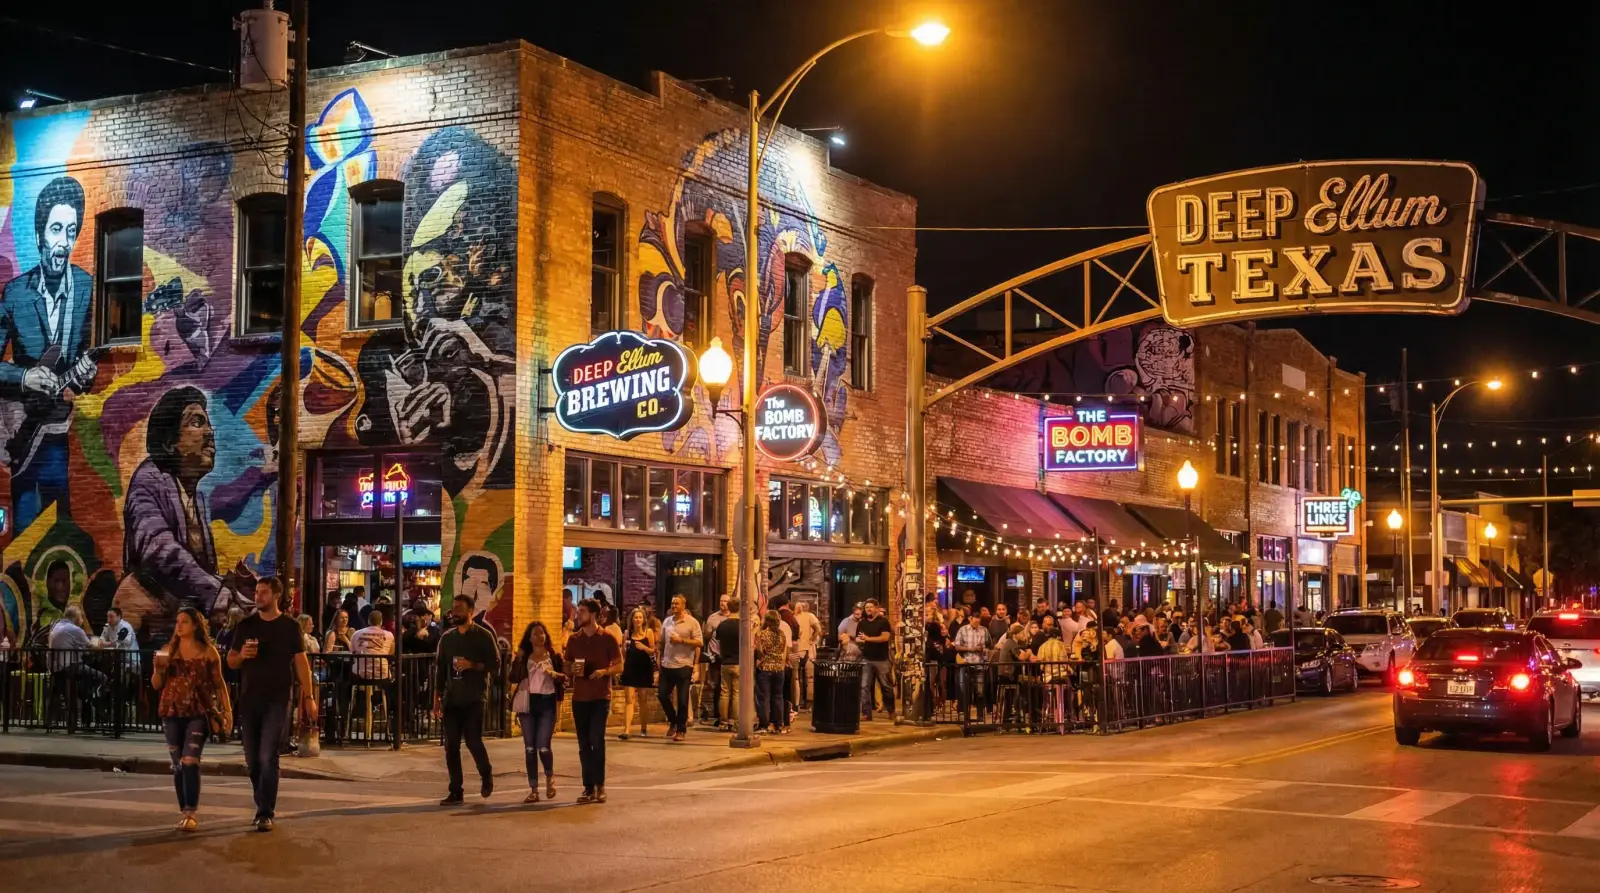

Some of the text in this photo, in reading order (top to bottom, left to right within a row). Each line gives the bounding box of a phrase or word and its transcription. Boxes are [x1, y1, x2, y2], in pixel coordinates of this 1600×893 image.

[1176, 173, 1447, 242] DEEP Ellum
[1176, 237, 1447, 303] TEXAS
[574, 347, 663, 384] DEEP Ellum
[567, 366, 670, 416] BREWING
[637, 398, 664, 418] CO.
[765, 396, 786, 409] The
[765, 409, 805, 425] BOMB
[1076, 409, 1107, 423] THE
[755, 424, 815, 440] FACTORY
[1051, 424, 1133, 448] BOMB
[1055, 449, 1128, 464] FACTORY
[1305, 501, 1348, 514] THREE
[1307, 513, 1347, 526] LINKS
